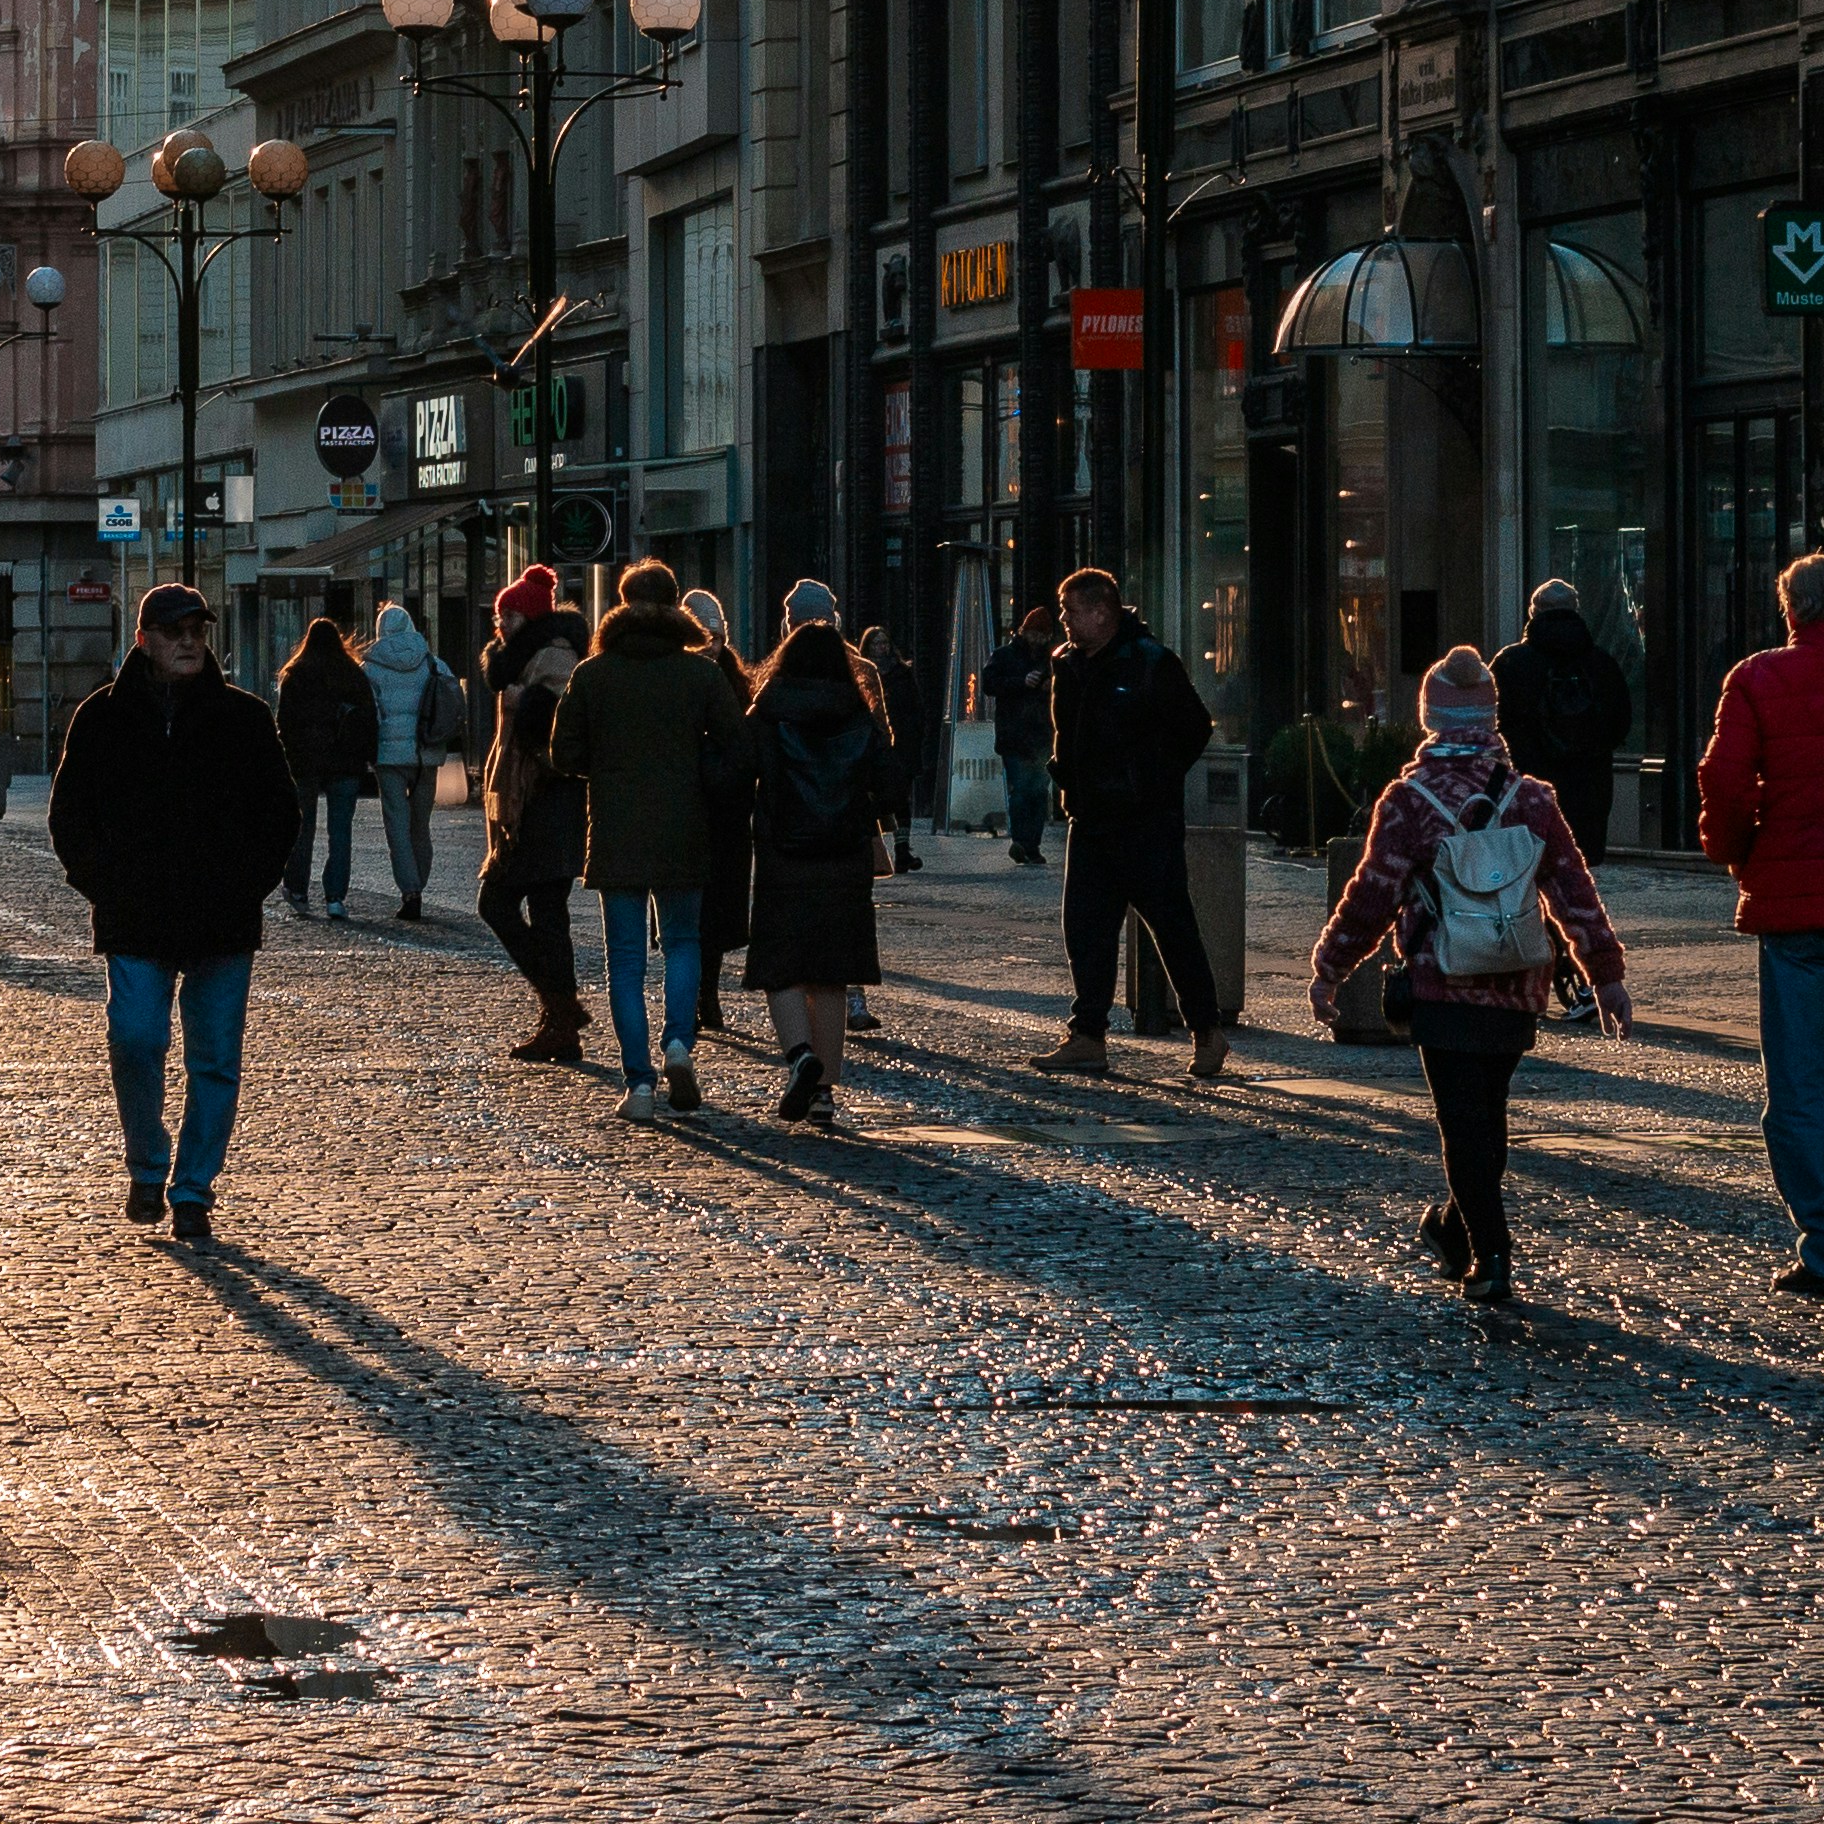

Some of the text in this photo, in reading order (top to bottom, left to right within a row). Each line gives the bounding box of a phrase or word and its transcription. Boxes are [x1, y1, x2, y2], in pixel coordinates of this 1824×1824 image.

[941, 242, 1007, 307] KITCHEN
[1081, 314, 1143, 333] PYLONES
[416, 395, 457, 459] PIZZA
[510, 375, 568, 446] HEO
[320, 426, 375, 440] PIZZA
[344, 438, 375, 447] FACTORY
